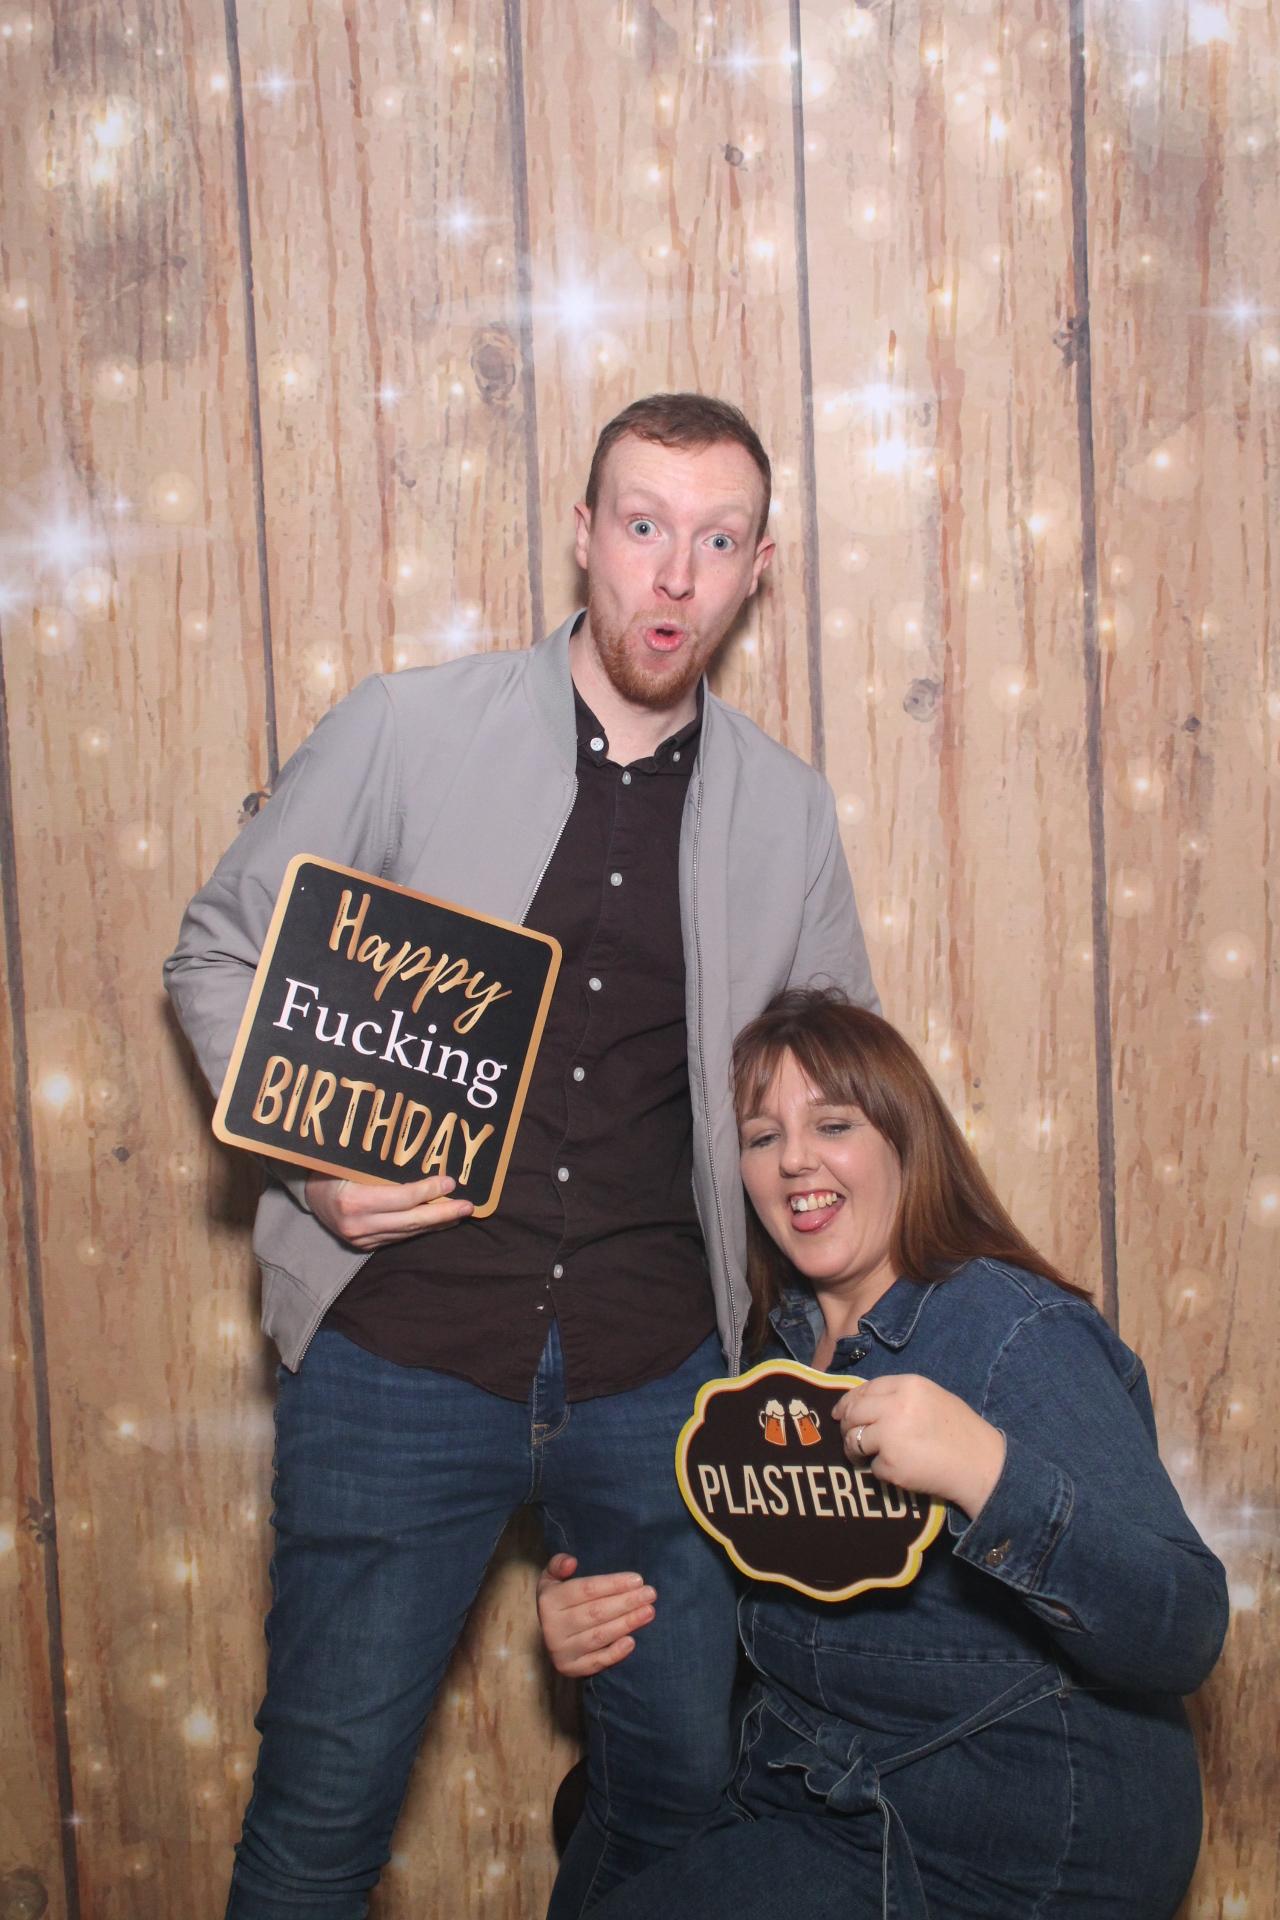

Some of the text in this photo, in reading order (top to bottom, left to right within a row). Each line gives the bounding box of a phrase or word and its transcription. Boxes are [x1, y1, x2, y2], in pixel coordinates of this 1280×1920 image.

[328, 889, 512, 1034] Happy
[272, 977, 507, 1108] Fucking
[252, 1055, 494, 1185] BIRTHDAY
